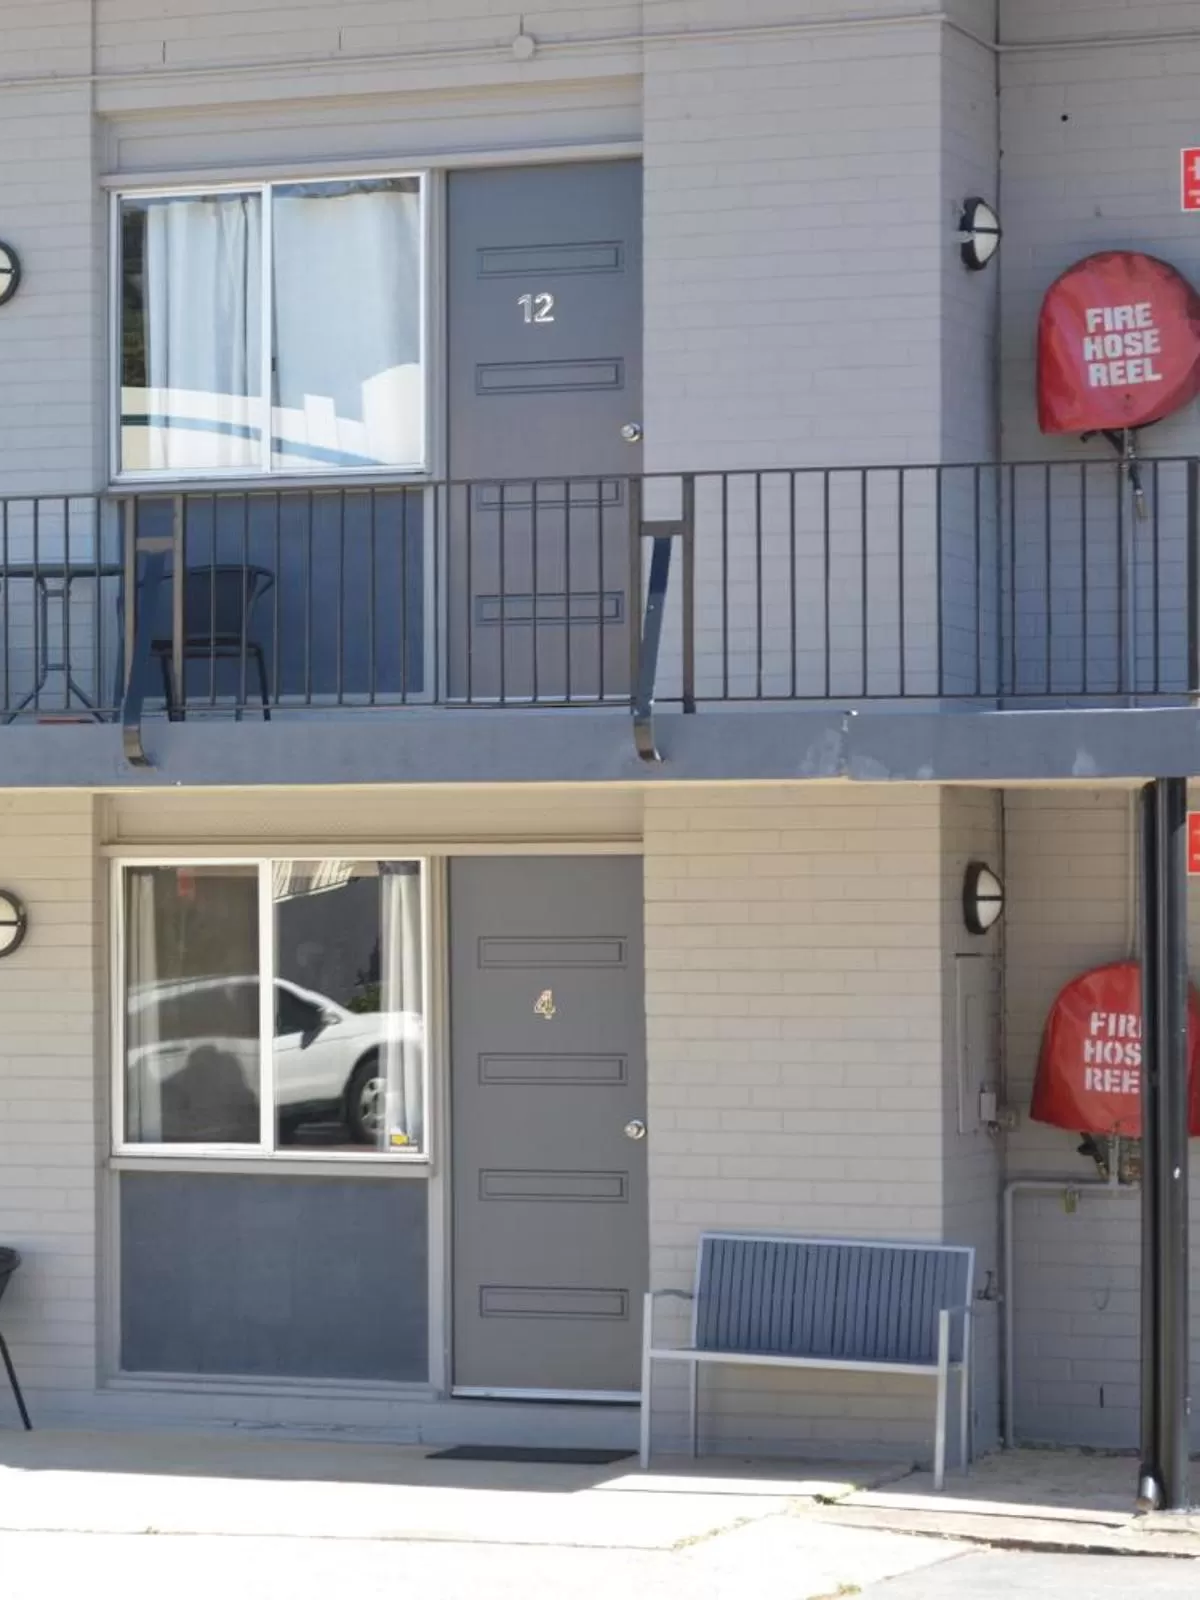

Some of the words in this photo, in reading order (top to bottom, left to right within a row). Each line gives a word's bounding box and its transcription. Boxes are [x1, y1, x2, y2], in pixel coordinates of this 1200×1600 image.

[517, 292, 554, 323] 12
[1085, 302, 1153, 333] FIRE
[1083, 328, 1161, 361] HOSE
[1088, 357, 1163, 387] REEL
[533, 988, 557, 1020] 4
[1090, 1011, 1141, 1038] FIR
[1083, 1038, 1141, 1066] HOS
[1084, 1067, 1140, 1094] REE
